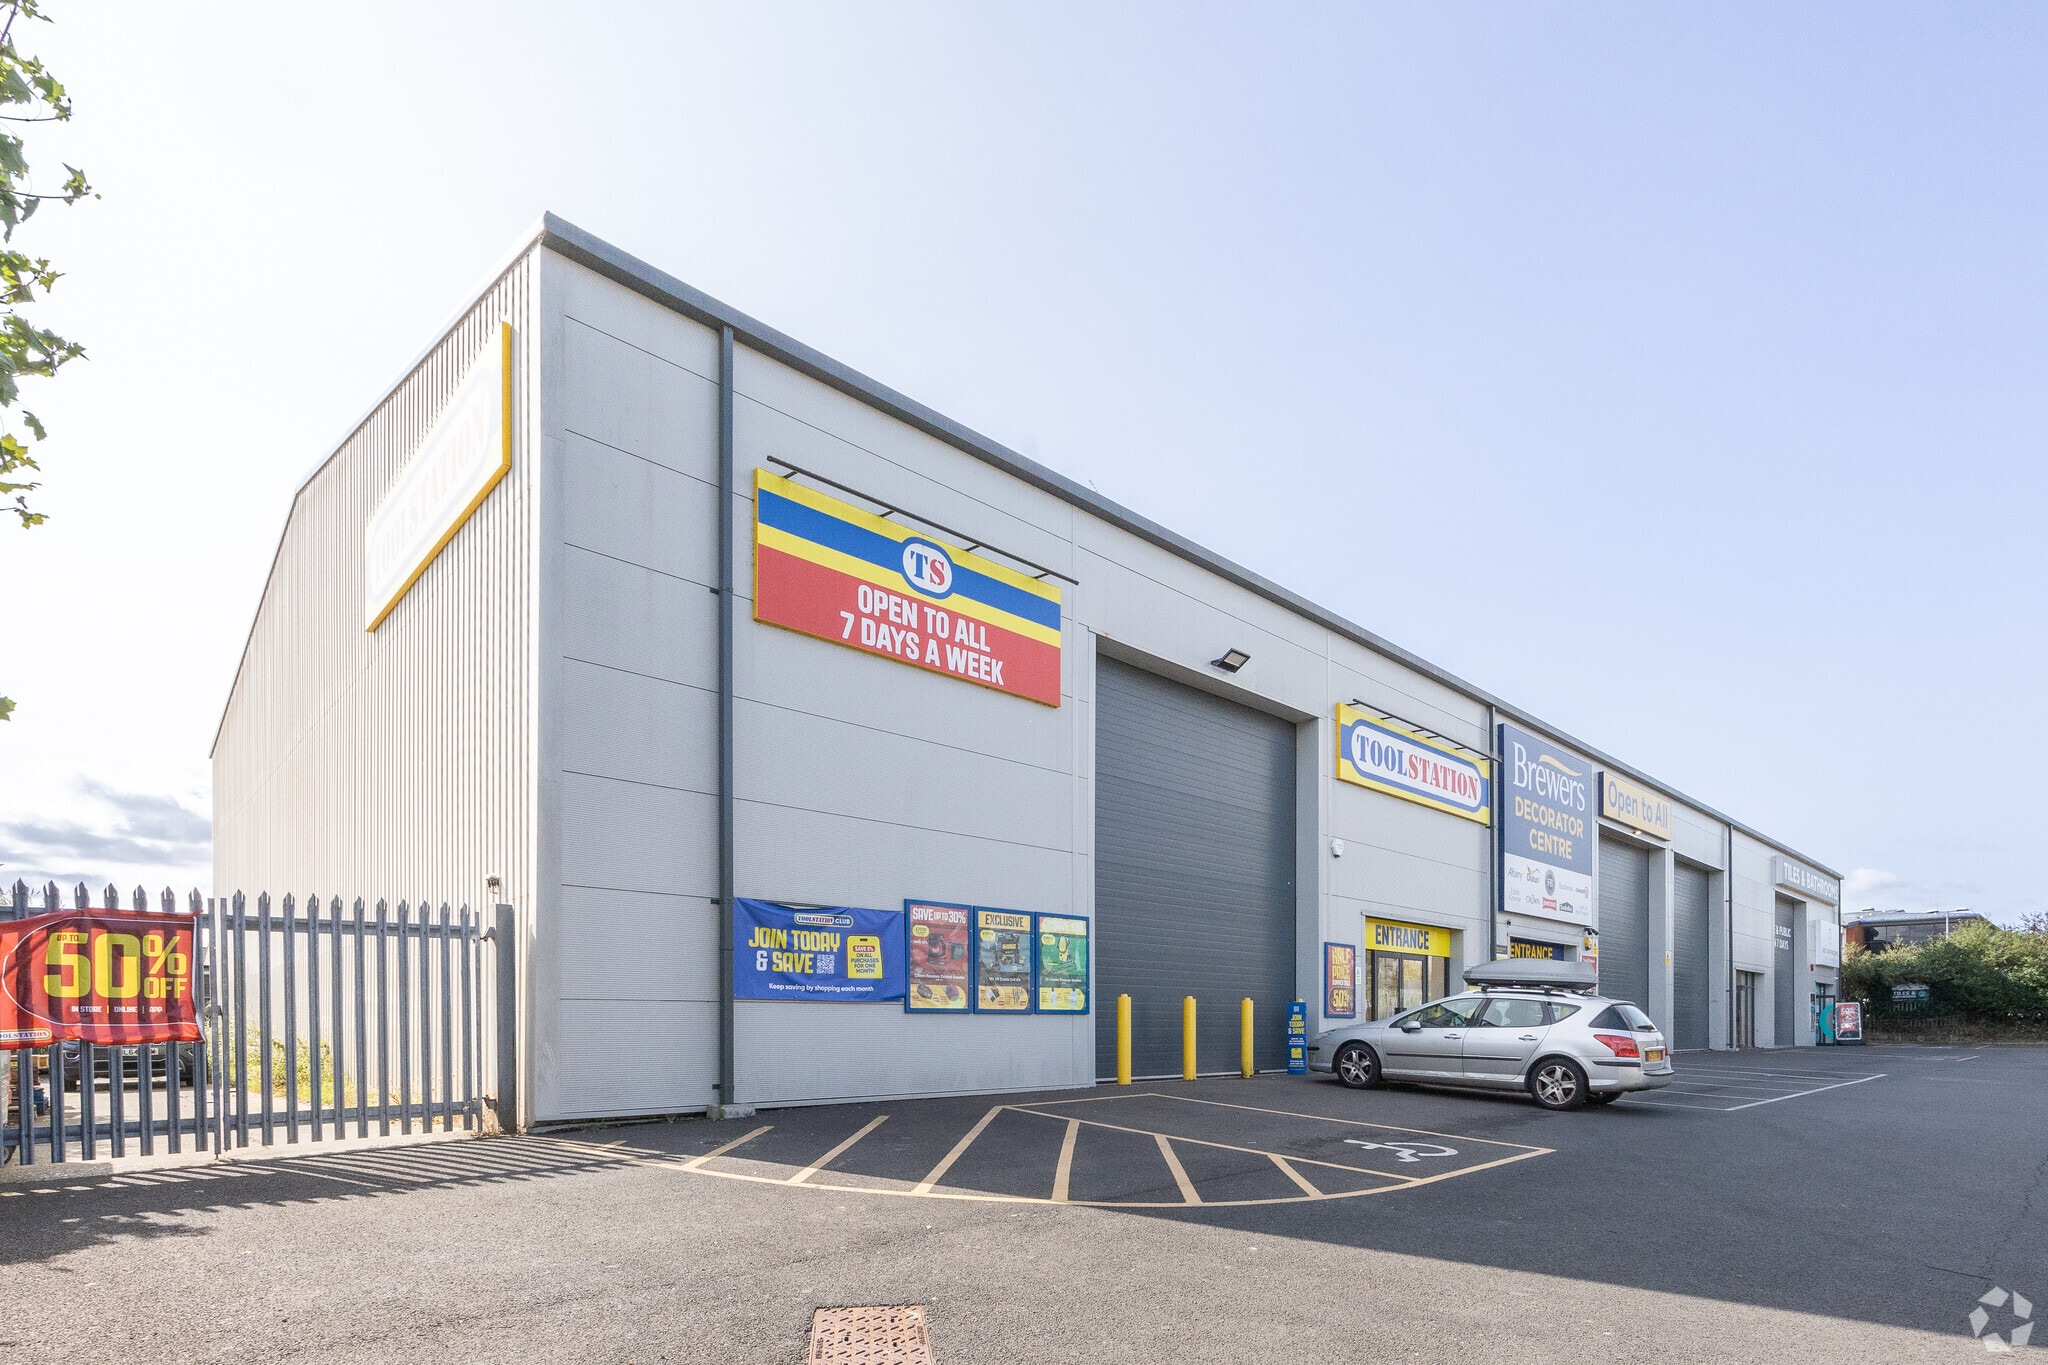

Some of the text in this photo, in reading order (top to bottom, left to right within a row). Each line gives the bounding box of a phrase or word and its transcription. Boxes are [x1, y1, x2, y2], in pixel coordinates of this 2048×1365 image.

[910, 550, 945, 586] TS
[858, 584, 991, 652] OPEN TO ALL
[840, 611, 1004, 685] 7 DAYS A WEEK
[1356, 734, 1478, 801] TOOLSTATION
[1513, 741, 1585, 812] Brewers
[1515, 796, 1584, 839] DECORATOR
[1608, 780, 1668, 830] Open to All
[1529, 828, 1572, 860] CENTRE
[1784, 862, 1839, 900] TILES & BATHROOMS
[912, 908, 933, 921] SAVE
[948, 911, 966, 923] 30%
[985, 914, 1024, 927] EXCLUSIVE
[56, 934, 79, 942] UP TO
[749, 927, 840, 953] JOIN TODAY
[1375, 924, 1429, 950] ENTRANCE
[1510, 942, 1553, 960] ENTRANCE
[43, 932, 187, 999] 50%
[756, 950, 814, 974] & SAVE
[143, 977, 187, 999] OFF
[769, 983, 784, 991] Keep
[785, 984, 805, 992] saving
[806, 984, 814, 992] by
[814, 984, 840, 992] shopping
